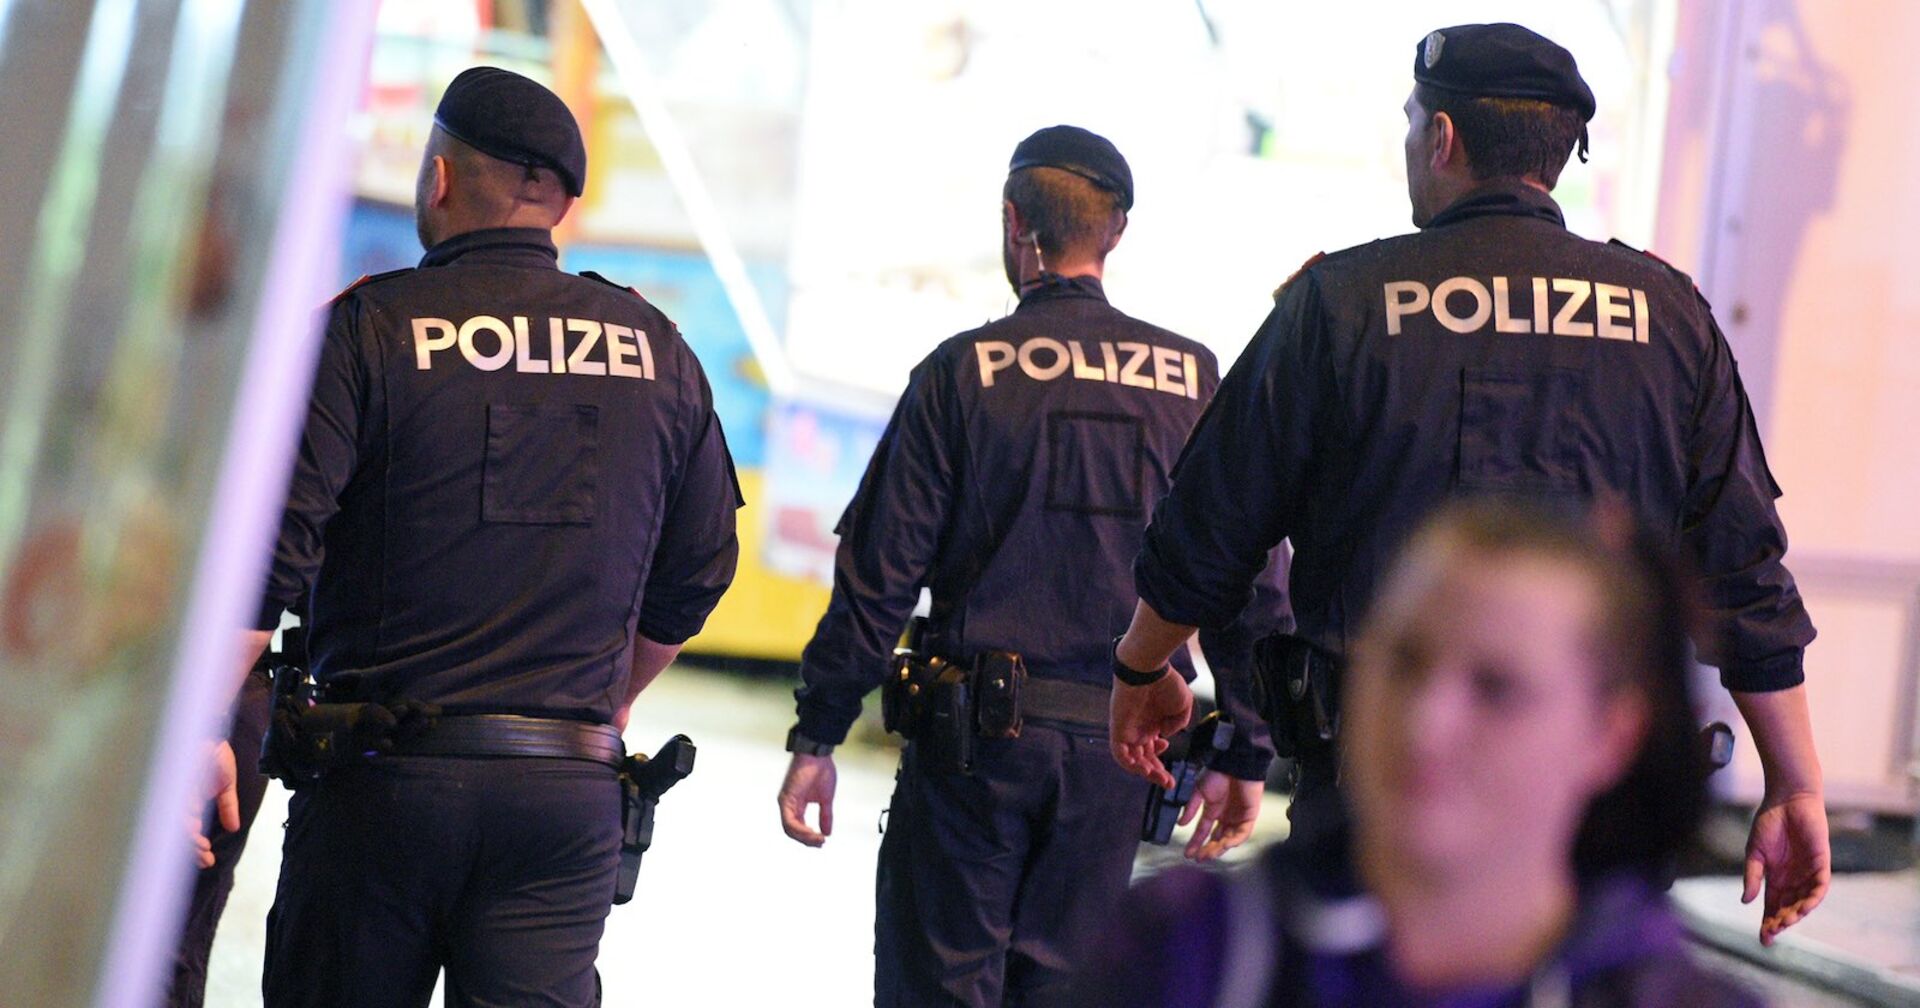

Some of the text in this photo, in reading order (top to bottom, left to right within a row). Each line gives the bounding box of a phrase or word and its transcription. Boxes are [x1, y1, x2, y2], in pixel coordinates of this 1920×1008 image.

[1384, 276, 1650, 344] POLIZEI
[411, 315, 656, 380] POLIZEI
[975, 337, 1199, 400] POLIZEI
